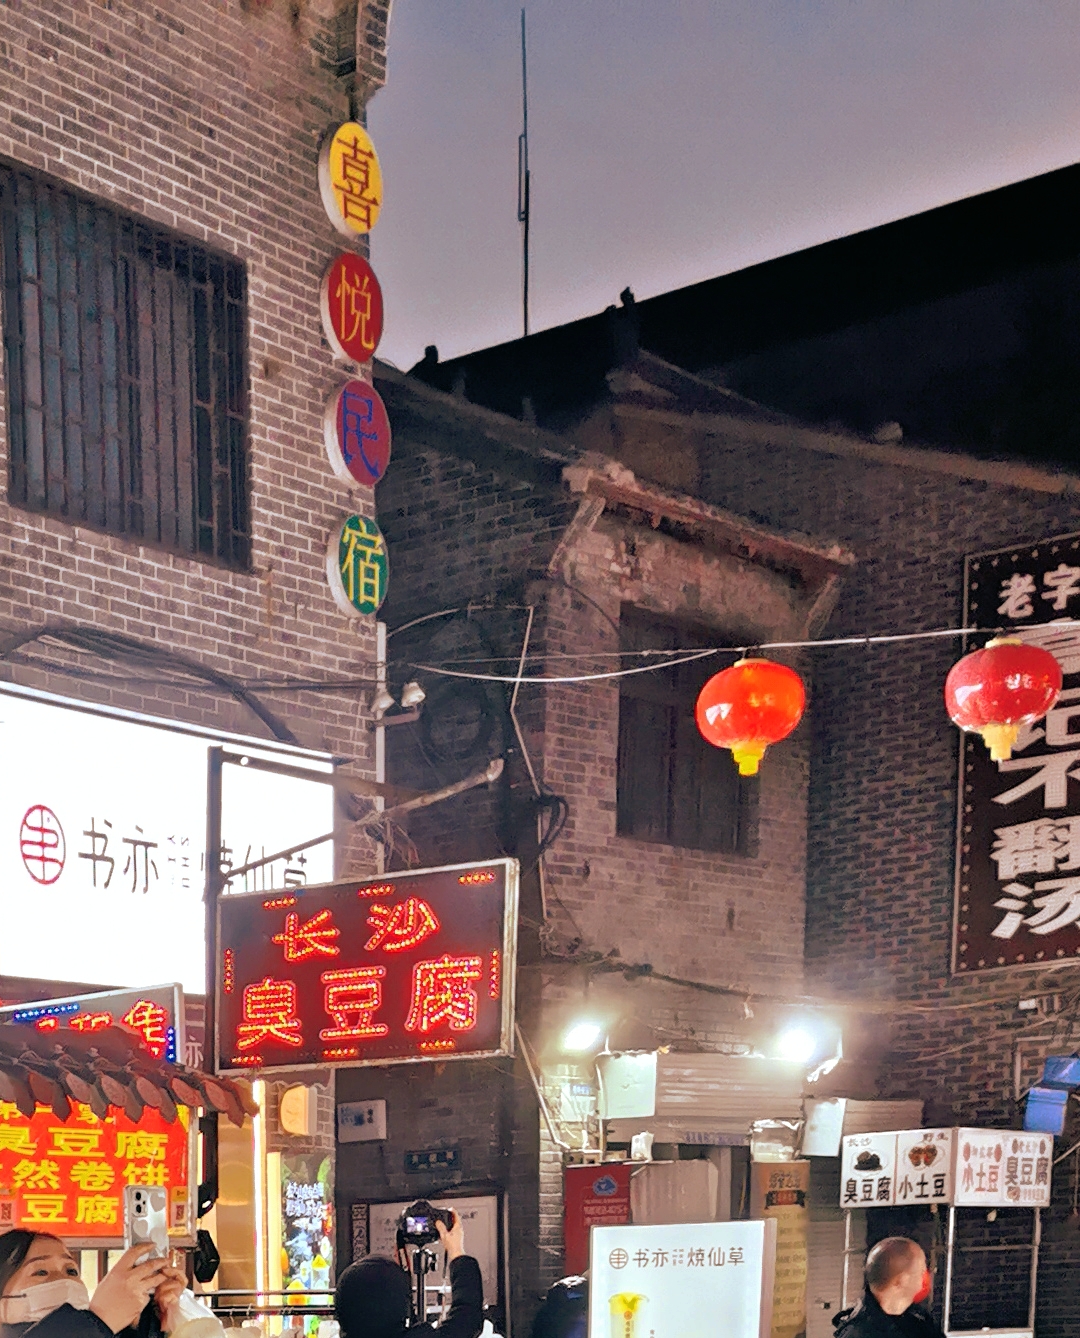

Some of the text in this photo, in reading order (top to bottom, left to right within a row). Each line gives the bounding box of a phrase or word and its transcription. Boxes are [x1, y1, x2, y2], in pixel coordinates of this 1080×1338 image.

[335, 136, 384, 609] 喜悦民宿
[78, 816, 159, 894] 书亦
[272, 897, 441, 961] 长沙
[237, 953, 484, 1049] 臭豆腐
[844, 1177, 892, 1203] 臭豆腐
[899, 1173, 946, 1199] 小土豆
[962, 1163, 999, 1192] 小土豆
[1005, 1156, 1049, 1185] 臭豆腐
